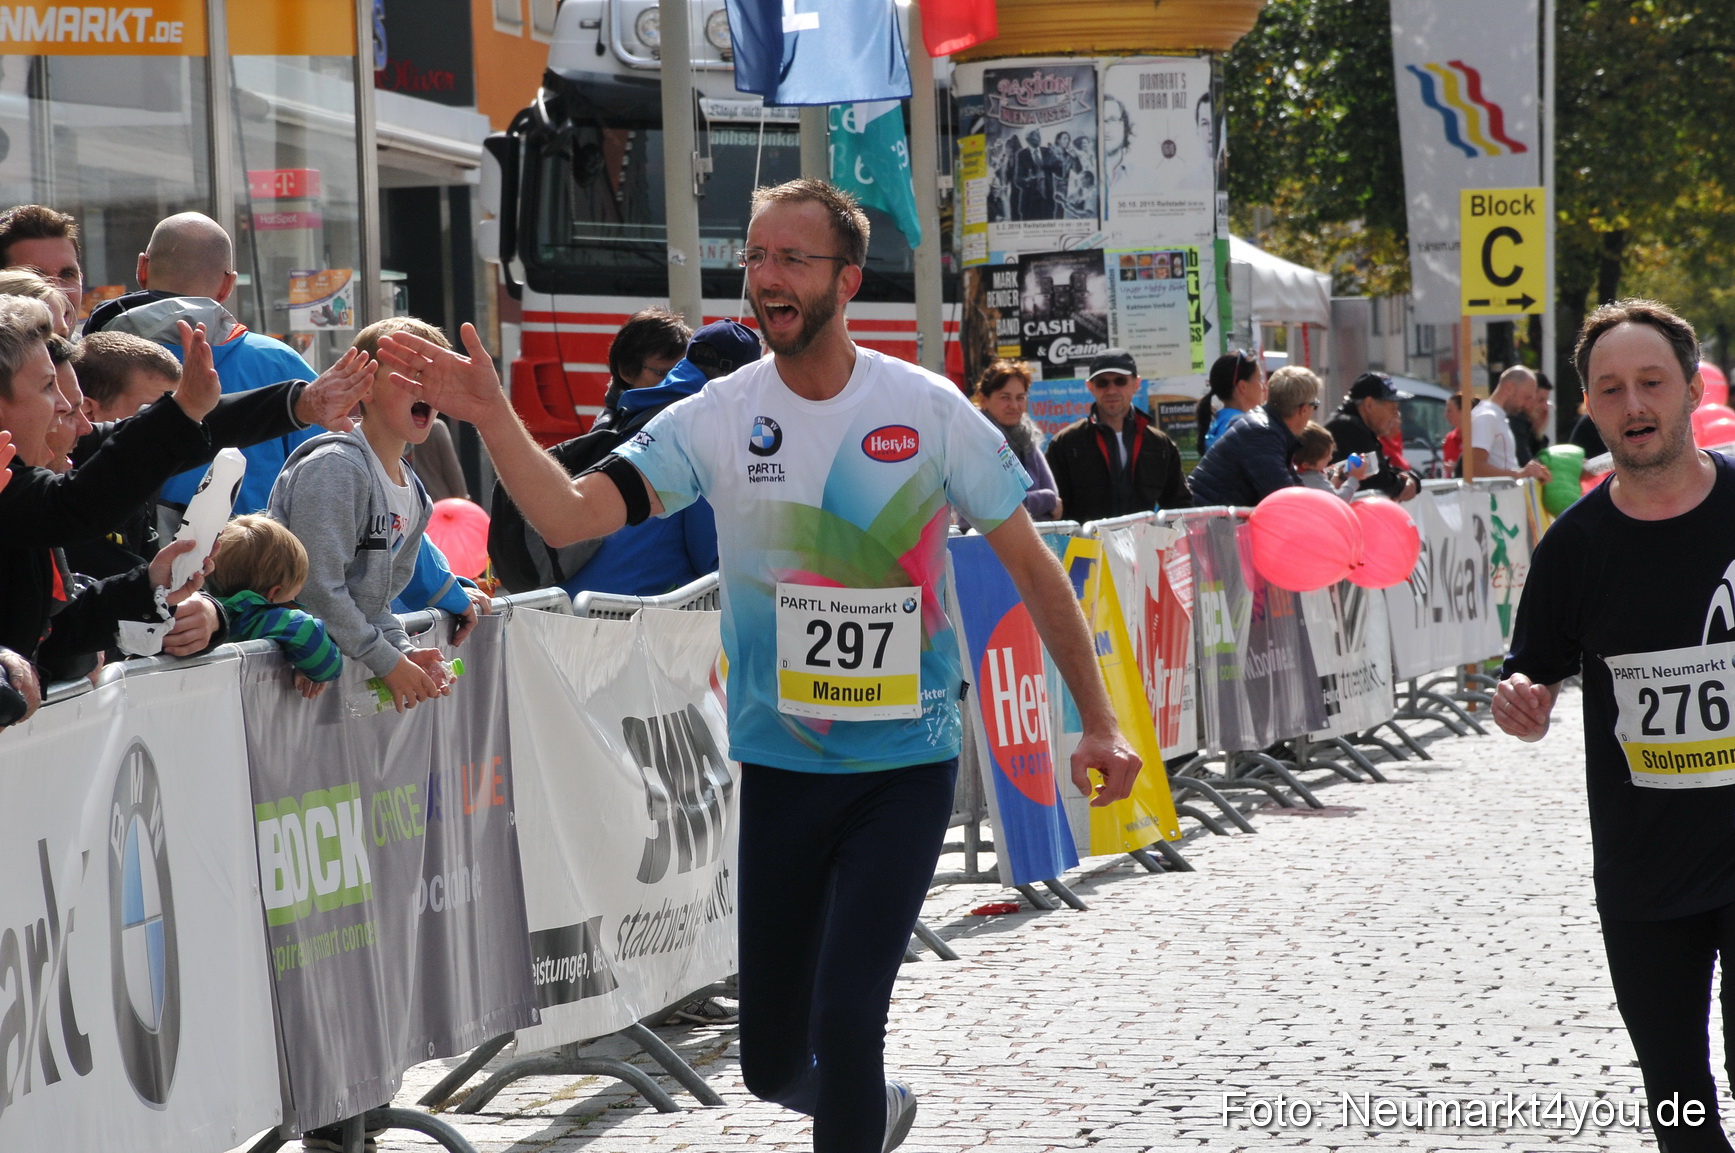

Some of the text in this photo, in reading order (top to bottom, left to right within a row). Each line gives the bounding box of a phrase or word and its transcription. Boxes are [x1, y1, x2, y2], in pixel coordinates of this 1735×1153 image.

[1470, 194, 1536, 217] Block
[260, 213, 297, 224] HotSpot
[1481, 226, 1524, 287] C
[992, 271, 1019, 289] MARK
[995, 318, 1020, 337] BAND
[1023, 319, 1076, 338] CASH
[870, 435, 916, 453] Hervis
[747, 462, 786, 476] PARTL
[780, 595, 898, 616] PARTL Neumarkt
[805, 619, 895, 670] 297
[1613, 659, 1727, 681] PARTL Neumarkt
[812, 680, 882, 703] Manuel
[1638, 679, 1730, 737] 276
[258, 797, 372, 911] BOCK
